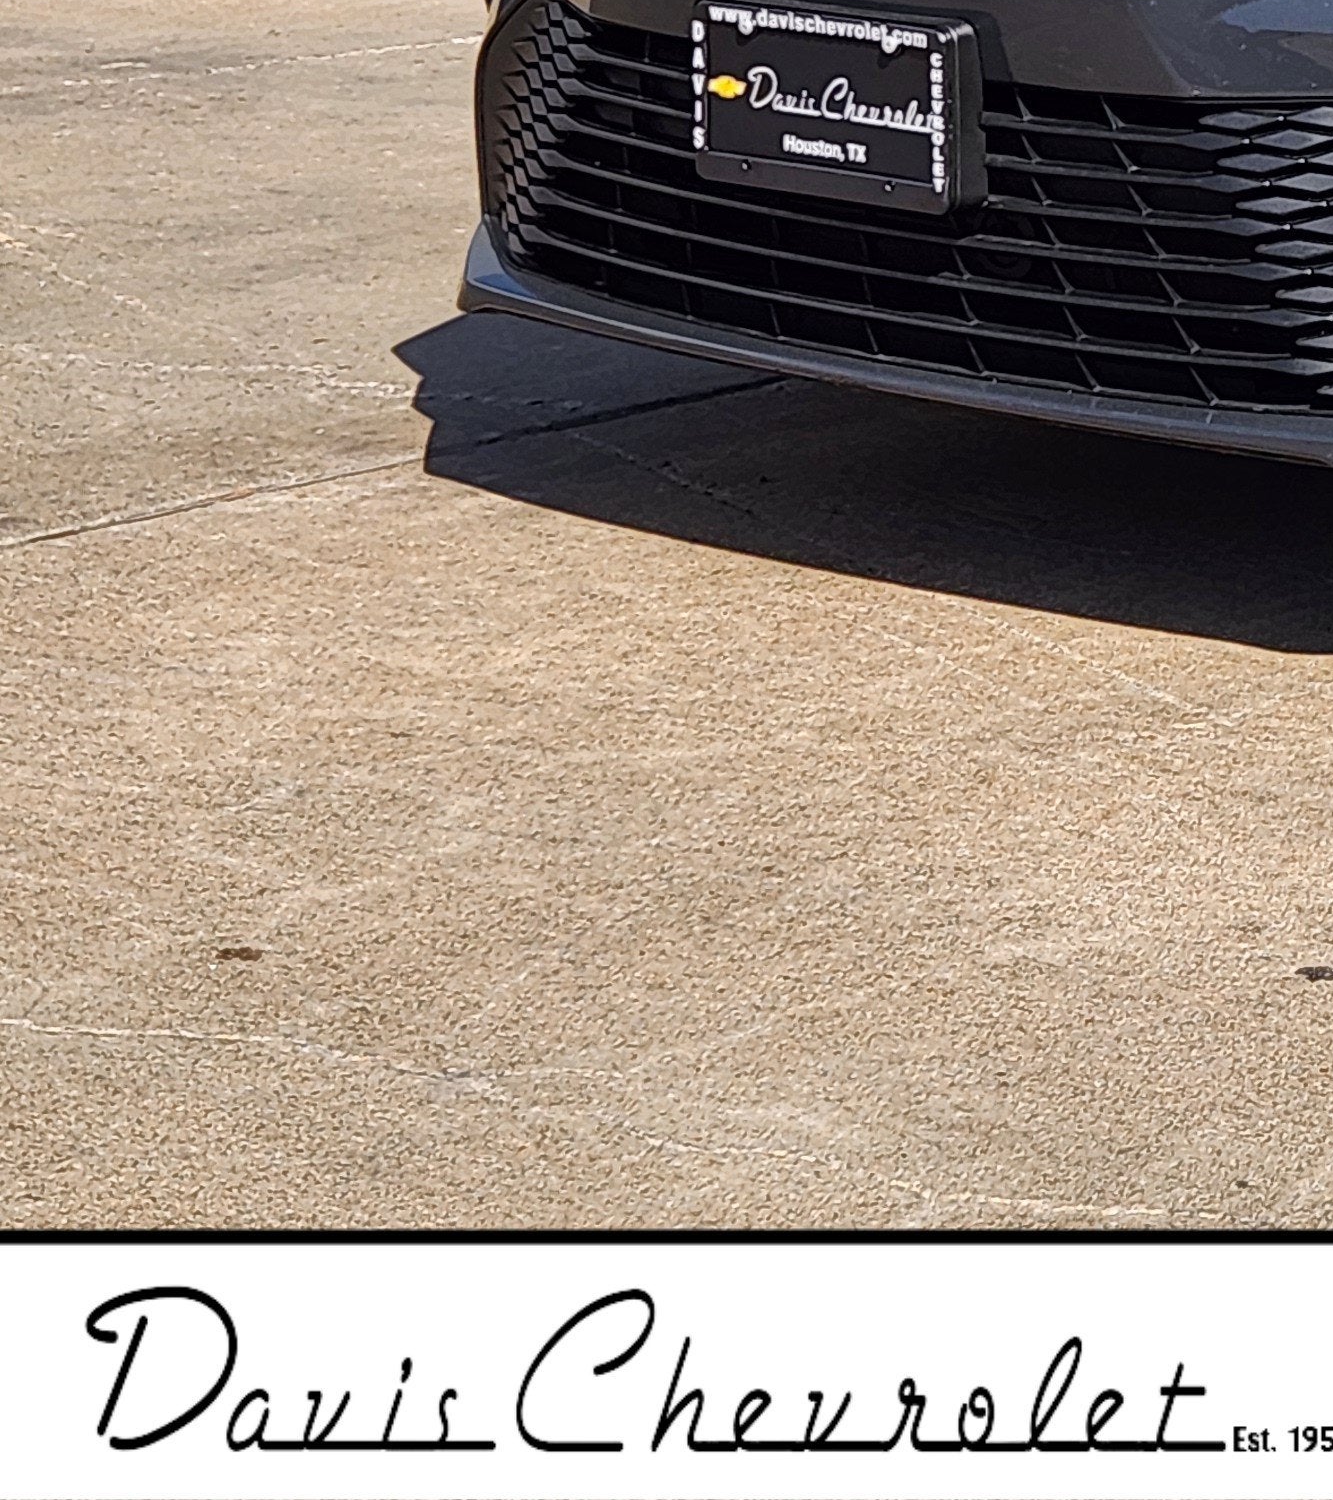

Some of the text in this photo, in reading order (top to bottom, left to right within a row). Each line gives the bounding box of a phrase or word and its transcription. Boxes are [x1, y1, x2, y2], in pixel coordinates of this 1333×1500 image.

[691, 19, 706, 150] DAVIS
[747, 65, 822, 117] Davis
[929, 52, 945, 193] CHEVROLET
[783, 133, 867, 164] Houston, TX
